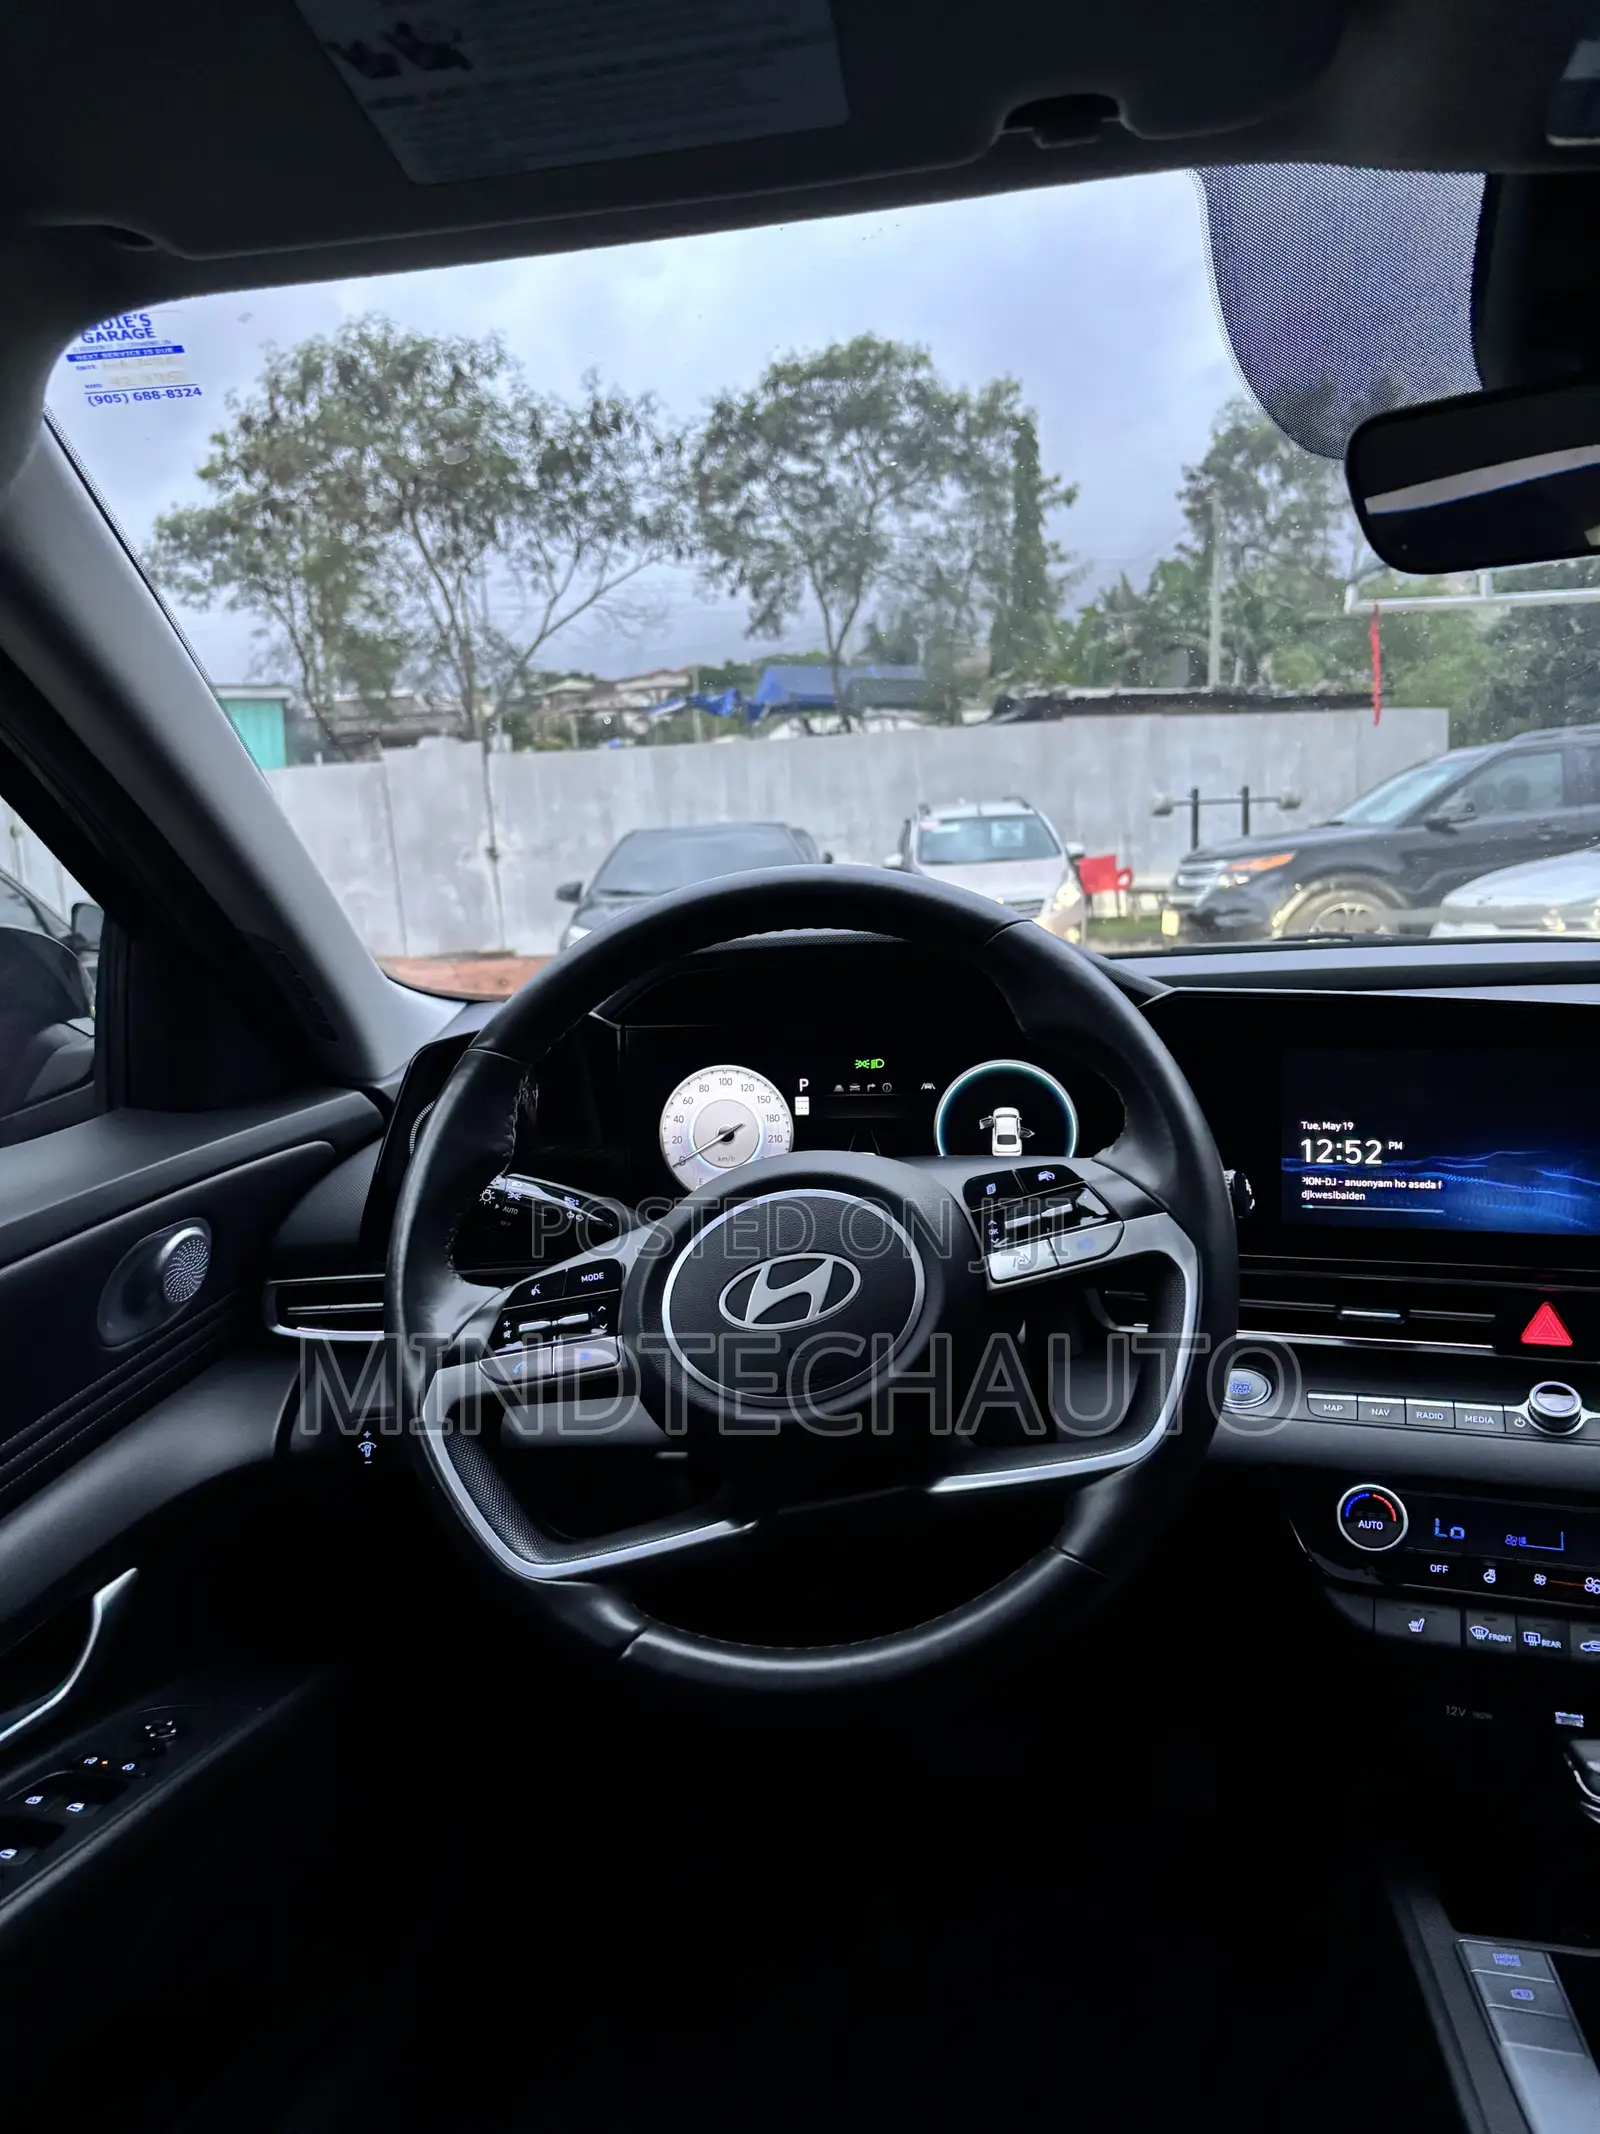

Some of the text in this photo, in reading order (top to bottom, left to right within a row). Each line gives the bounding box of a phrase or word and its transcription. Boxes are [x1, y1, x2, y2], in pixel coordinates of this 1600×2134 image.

[87, 314, 152, 331] DIE'S
[81, 328, 156, 344] GARAGE
[87, 387, 202, 408] (905) 688-8324
[718, 1077, 733, 1086] 100
[799, 1078, 810, 1092] P
[699, 1084, 710, 1093] 80
[740, 1083, 755, 1092] 120
[682, 1096, 694, 1105] 60
[757, 1095, 771, 1104] 150
[673, 1115, 685, 1124] 40
[766, 1114, 780, 1122] 180
[1301, 1121, 1354, 1132] Tue, May 19
[672, 1136, 683, 1144] 20
[768, 1135, 783, 1143] 210
[1301, 1138, 1403, 1165] 12:52 PM
[1344, 1180, 1393, 1189] anuonyam
[1394, 1180, 1407, 1189] ho
[1408, 1180, 1436, 1190] aseda
[502, 1206, 519, 1215] AUTO
[581, 1272, 604, 1283] MODE
[1323, 1404, 1343, 1412] MAP
[1371, 1408, 1390, 1416] NAV
[1416, 1411, 1444, 1420] RADIO
[1464, 1415, 1494, 1424] MEDIA
[1358, 1520, 1383, 1530] AUTO
[1434, 1517, 1465, 1540] Lo
[1430, 1564, 1449, 1573] OFF
[1488, 1633, 1512, 1643] FRONT
[1542, 1639, 1562, 1649] REAR
[1446, 1705, 1466, 1717] 12V
